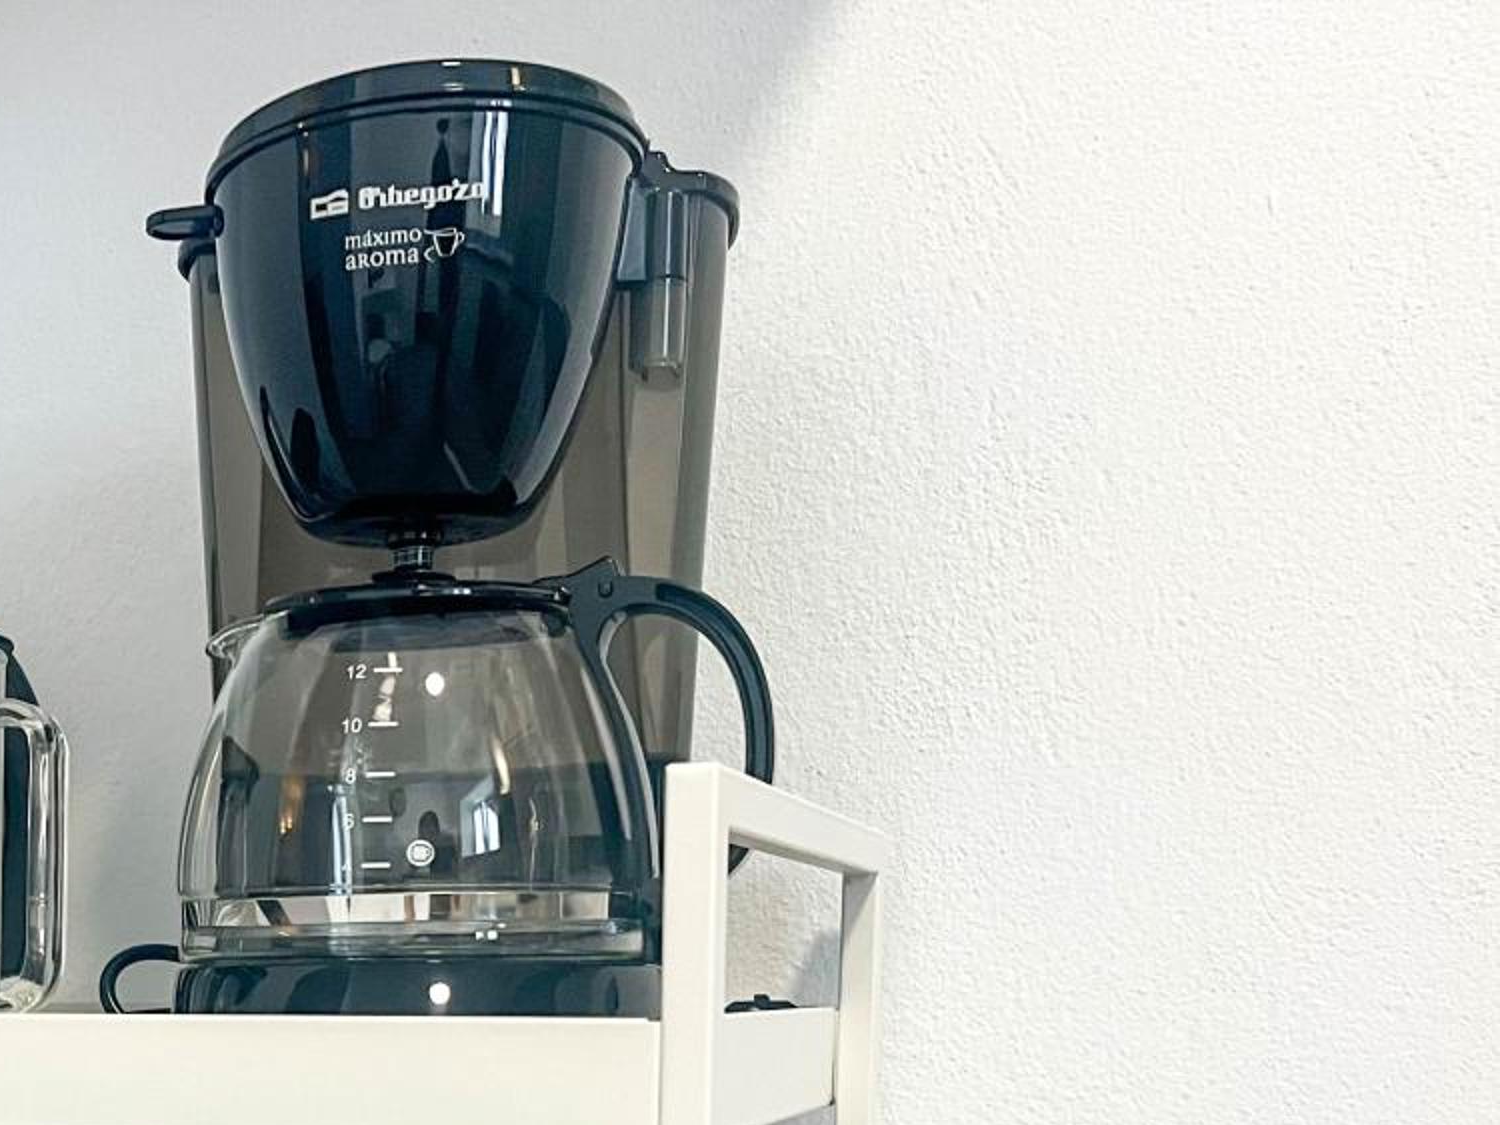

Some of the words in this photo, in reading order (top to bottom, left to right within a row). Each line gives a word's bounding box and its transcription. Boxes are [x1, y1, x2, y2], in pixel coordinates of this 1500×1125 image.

[345, 228, 422, 250] máximo
[347, 664, 367, 679] 12
[341, 718, 363, 734] 10
[344, 767, 356, 785] 8
